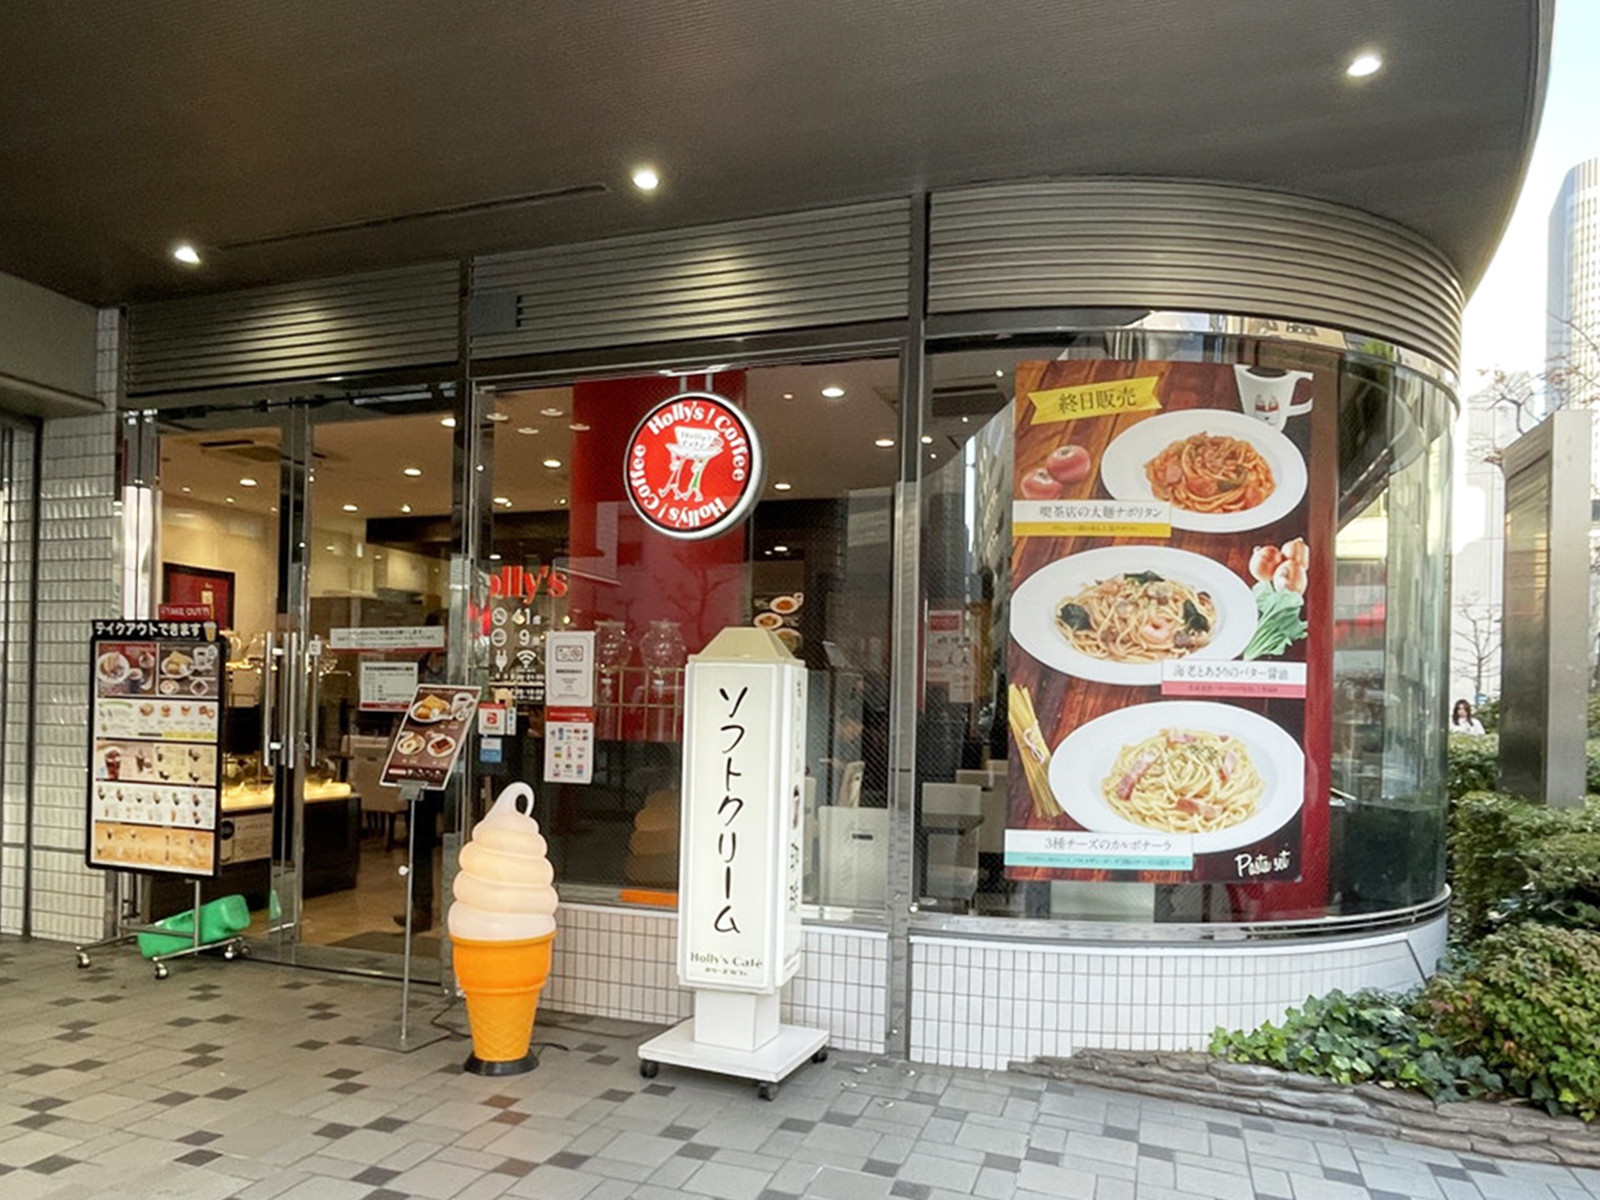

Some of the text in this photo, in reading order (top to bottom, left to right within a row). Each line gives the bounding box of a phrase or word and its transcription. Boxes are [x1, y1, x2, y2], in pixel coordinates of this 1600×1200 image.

[1058, 387, 1137, 413] 終日販売
[714, 415, 749, 481] Coffee
[629, 444, 660, 510] Coffee
[95, 622, 201, 636] テイクアウトできます
[1174, 664, 1290, 680] 海老とあさりのバター醤油
[713, 686, 748, 934] ソフトクリーム
[1045, 836, 1172, 851] 3種チーズのカルボナーラ
[1234, 853, 1272, 877] Pasta
[690, 952, 729, 965] Holly's
